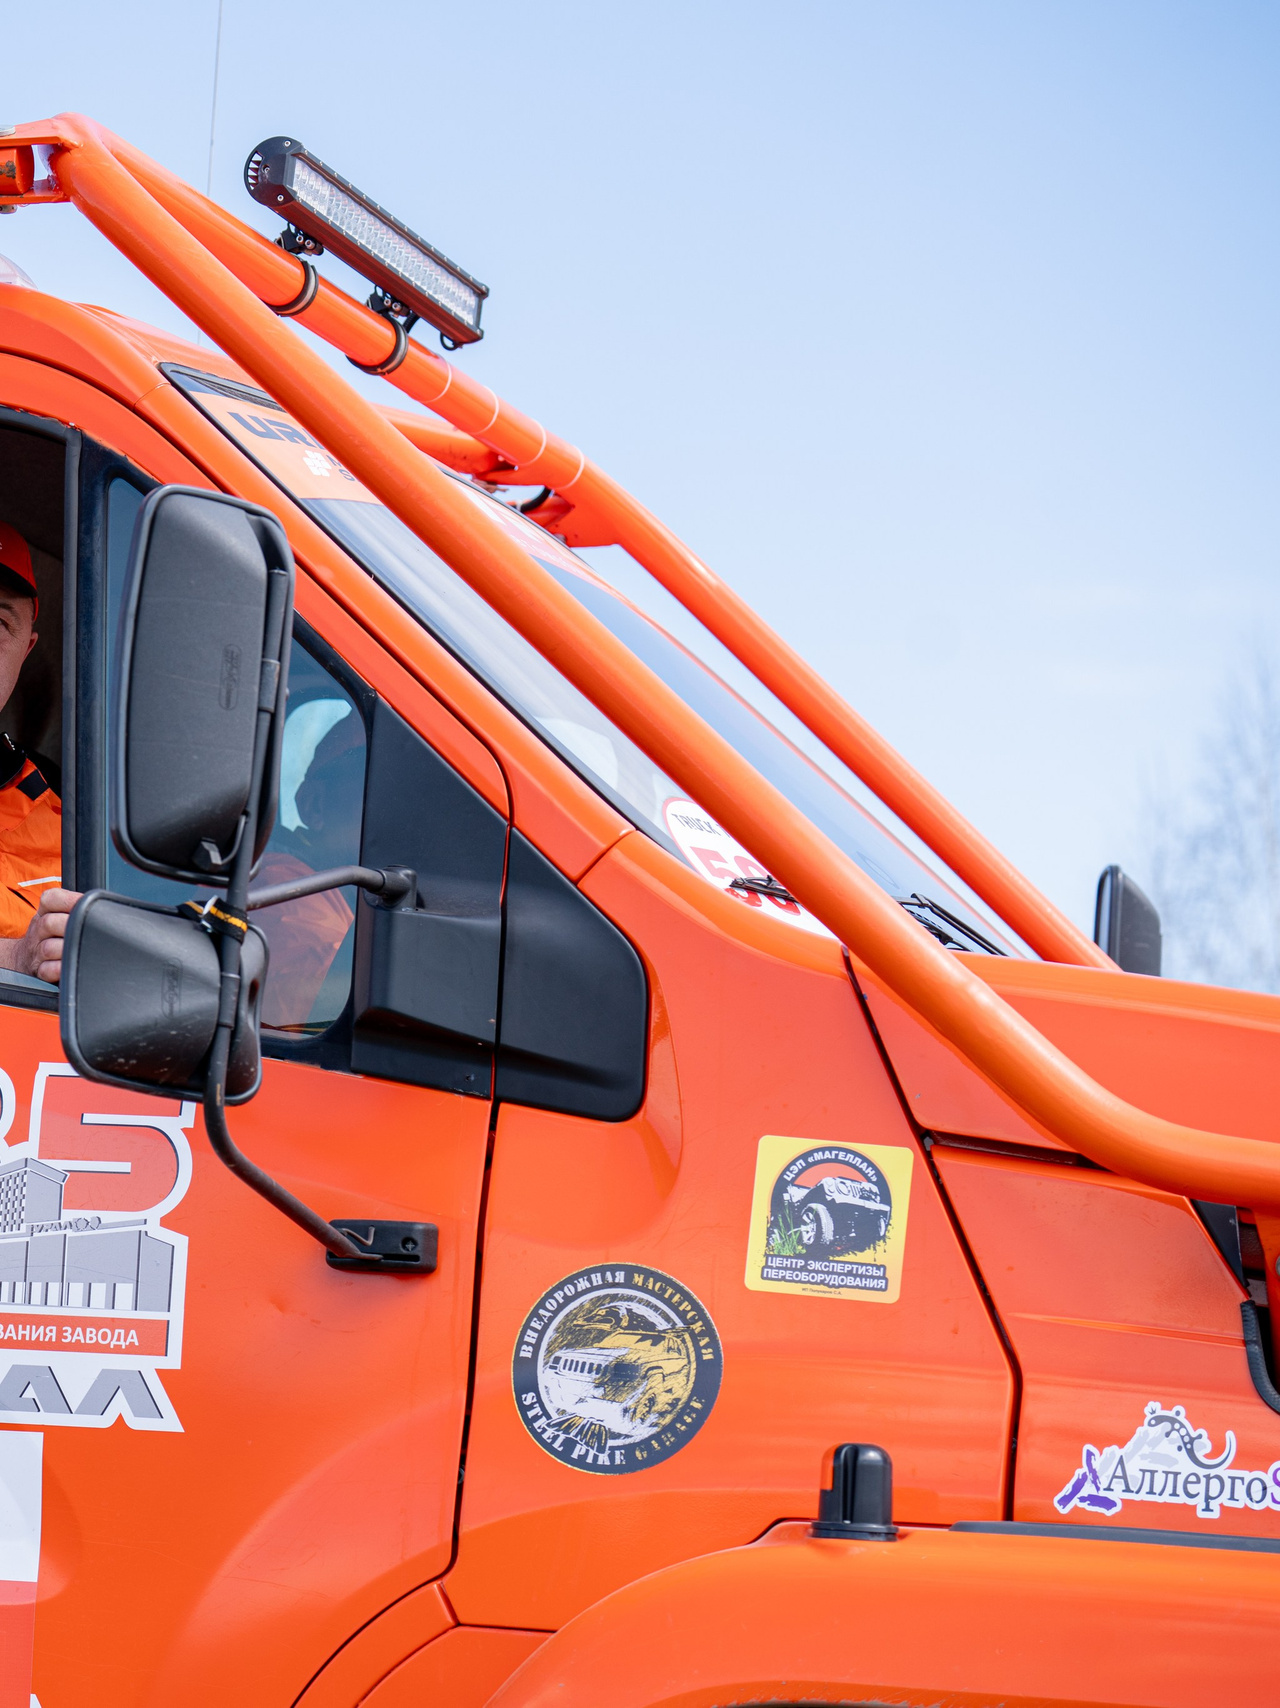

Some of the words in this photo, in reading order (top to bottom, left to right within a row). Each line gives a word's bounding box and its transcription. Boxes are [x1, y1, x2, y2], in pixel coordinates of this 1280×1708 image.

[227, 411, 326, 450] UR
[783, 1158, 807, 1182] ЦЭП
[807, 1150, 878, 1183] «МАГЕЛЛАН»
[767, 1256, 805, 1269] ЦЕНТР
[807, 1260, 884, 1277] ЭКСПЕРТИЗЫ
[763, 1268, 887, 1289] ПЕРЕОБОРУДОВАНИЯ
[520, 1271, 625, 1359] ВНЕДОРОЖНАЯ
[631, 1272, 714, 1361] МАСТЕРСКАЯ
[61, 1327, 139, 1349] ЗАВОДА
[571, 1444, 626, 1466] PIKE
